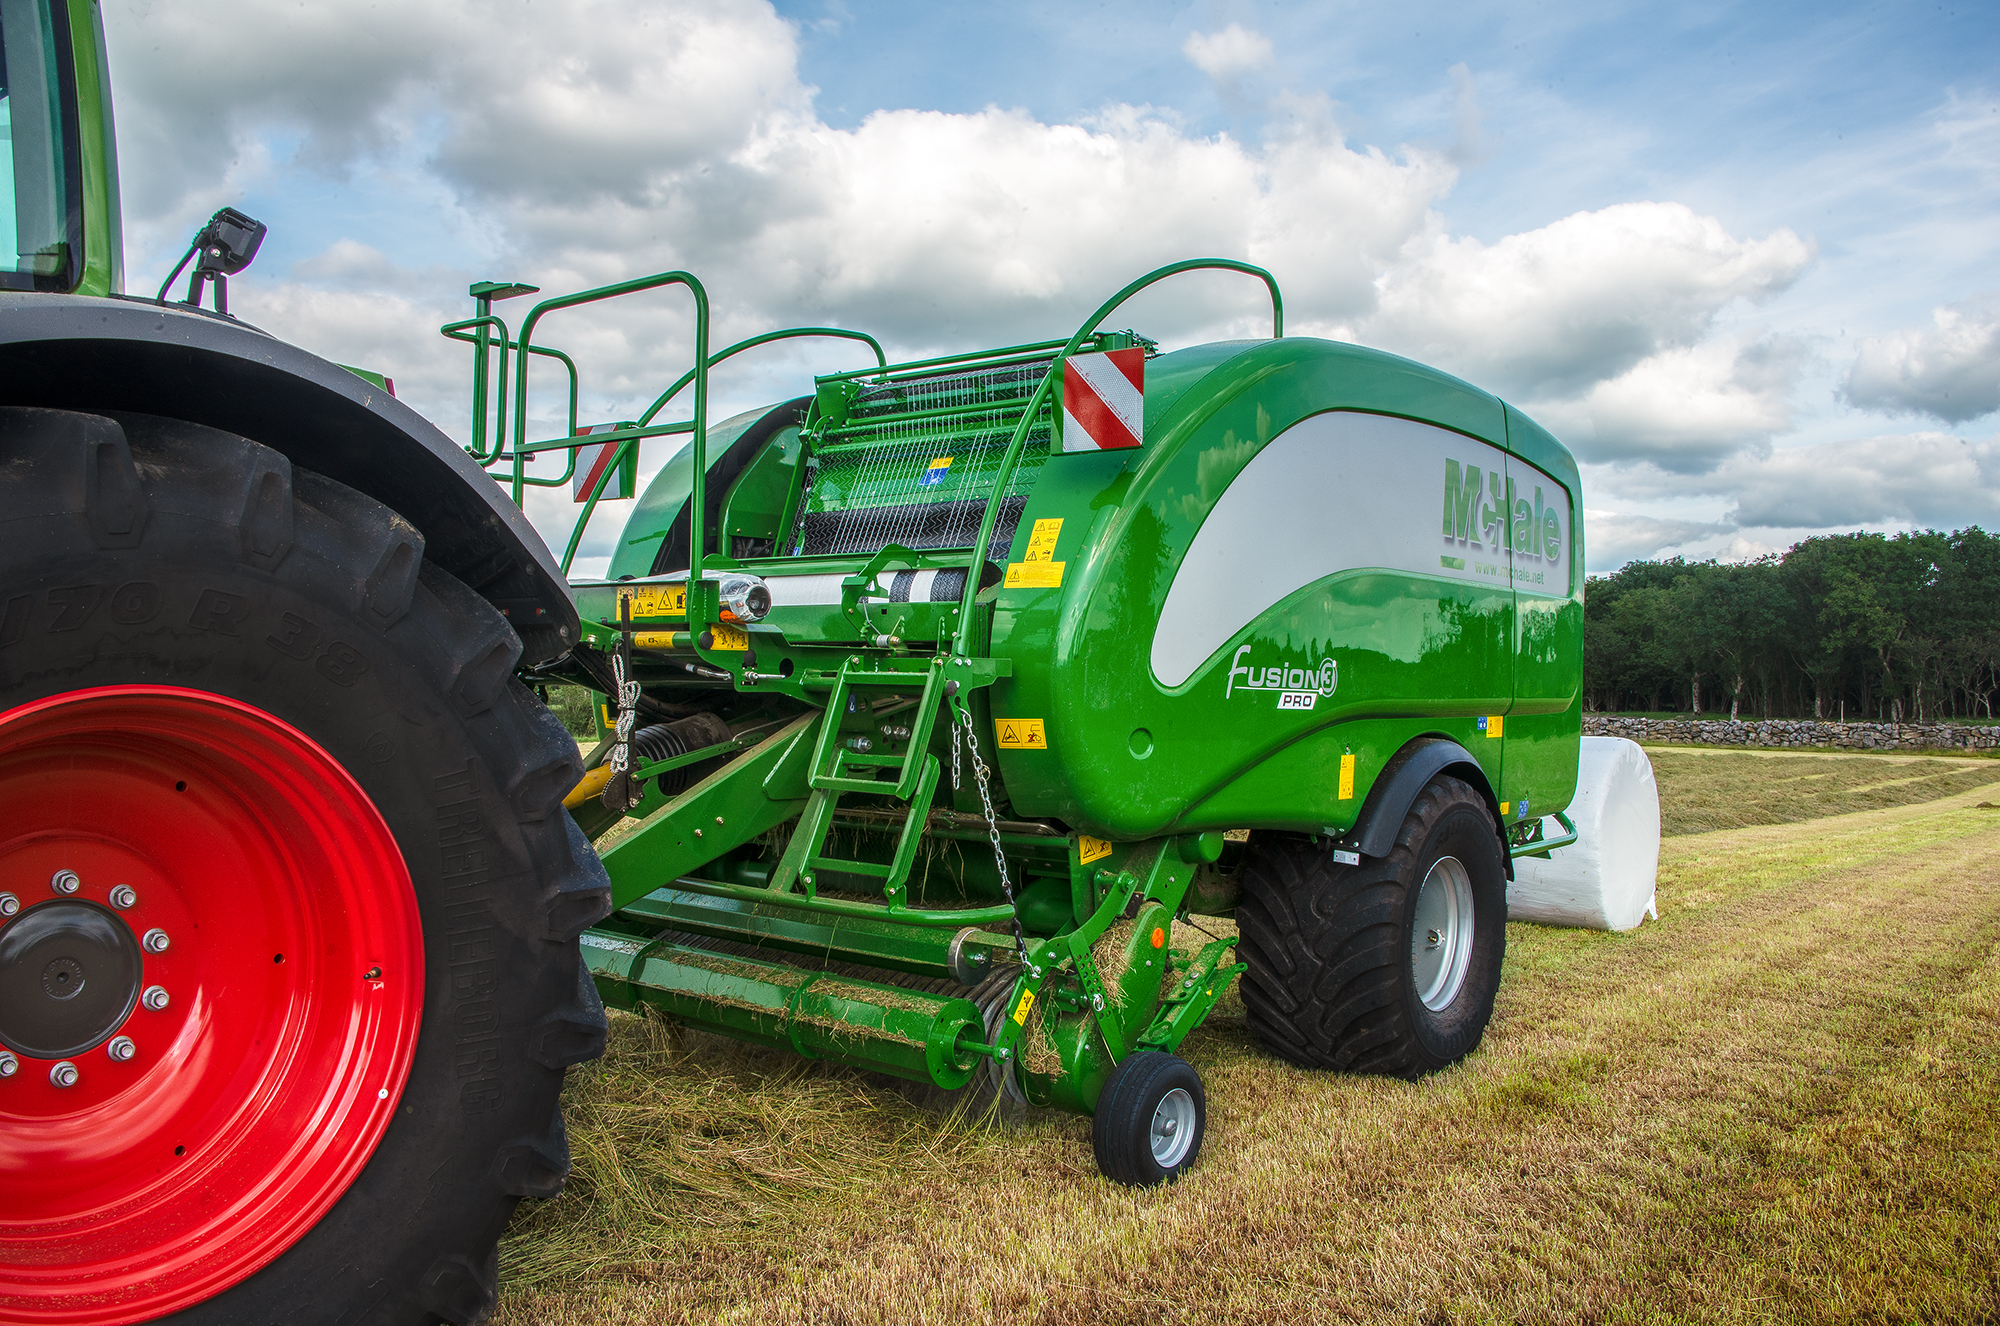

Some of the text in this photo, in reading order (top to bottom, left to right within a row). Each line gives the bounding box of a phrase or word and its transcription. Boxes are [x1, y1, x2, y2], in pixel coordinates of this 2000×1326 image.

[1442, 458, 1560, 561] McHale
[1282, 694, 1312, 708] PRO
[434, 756, 507, 1115] TRELLEBORG
